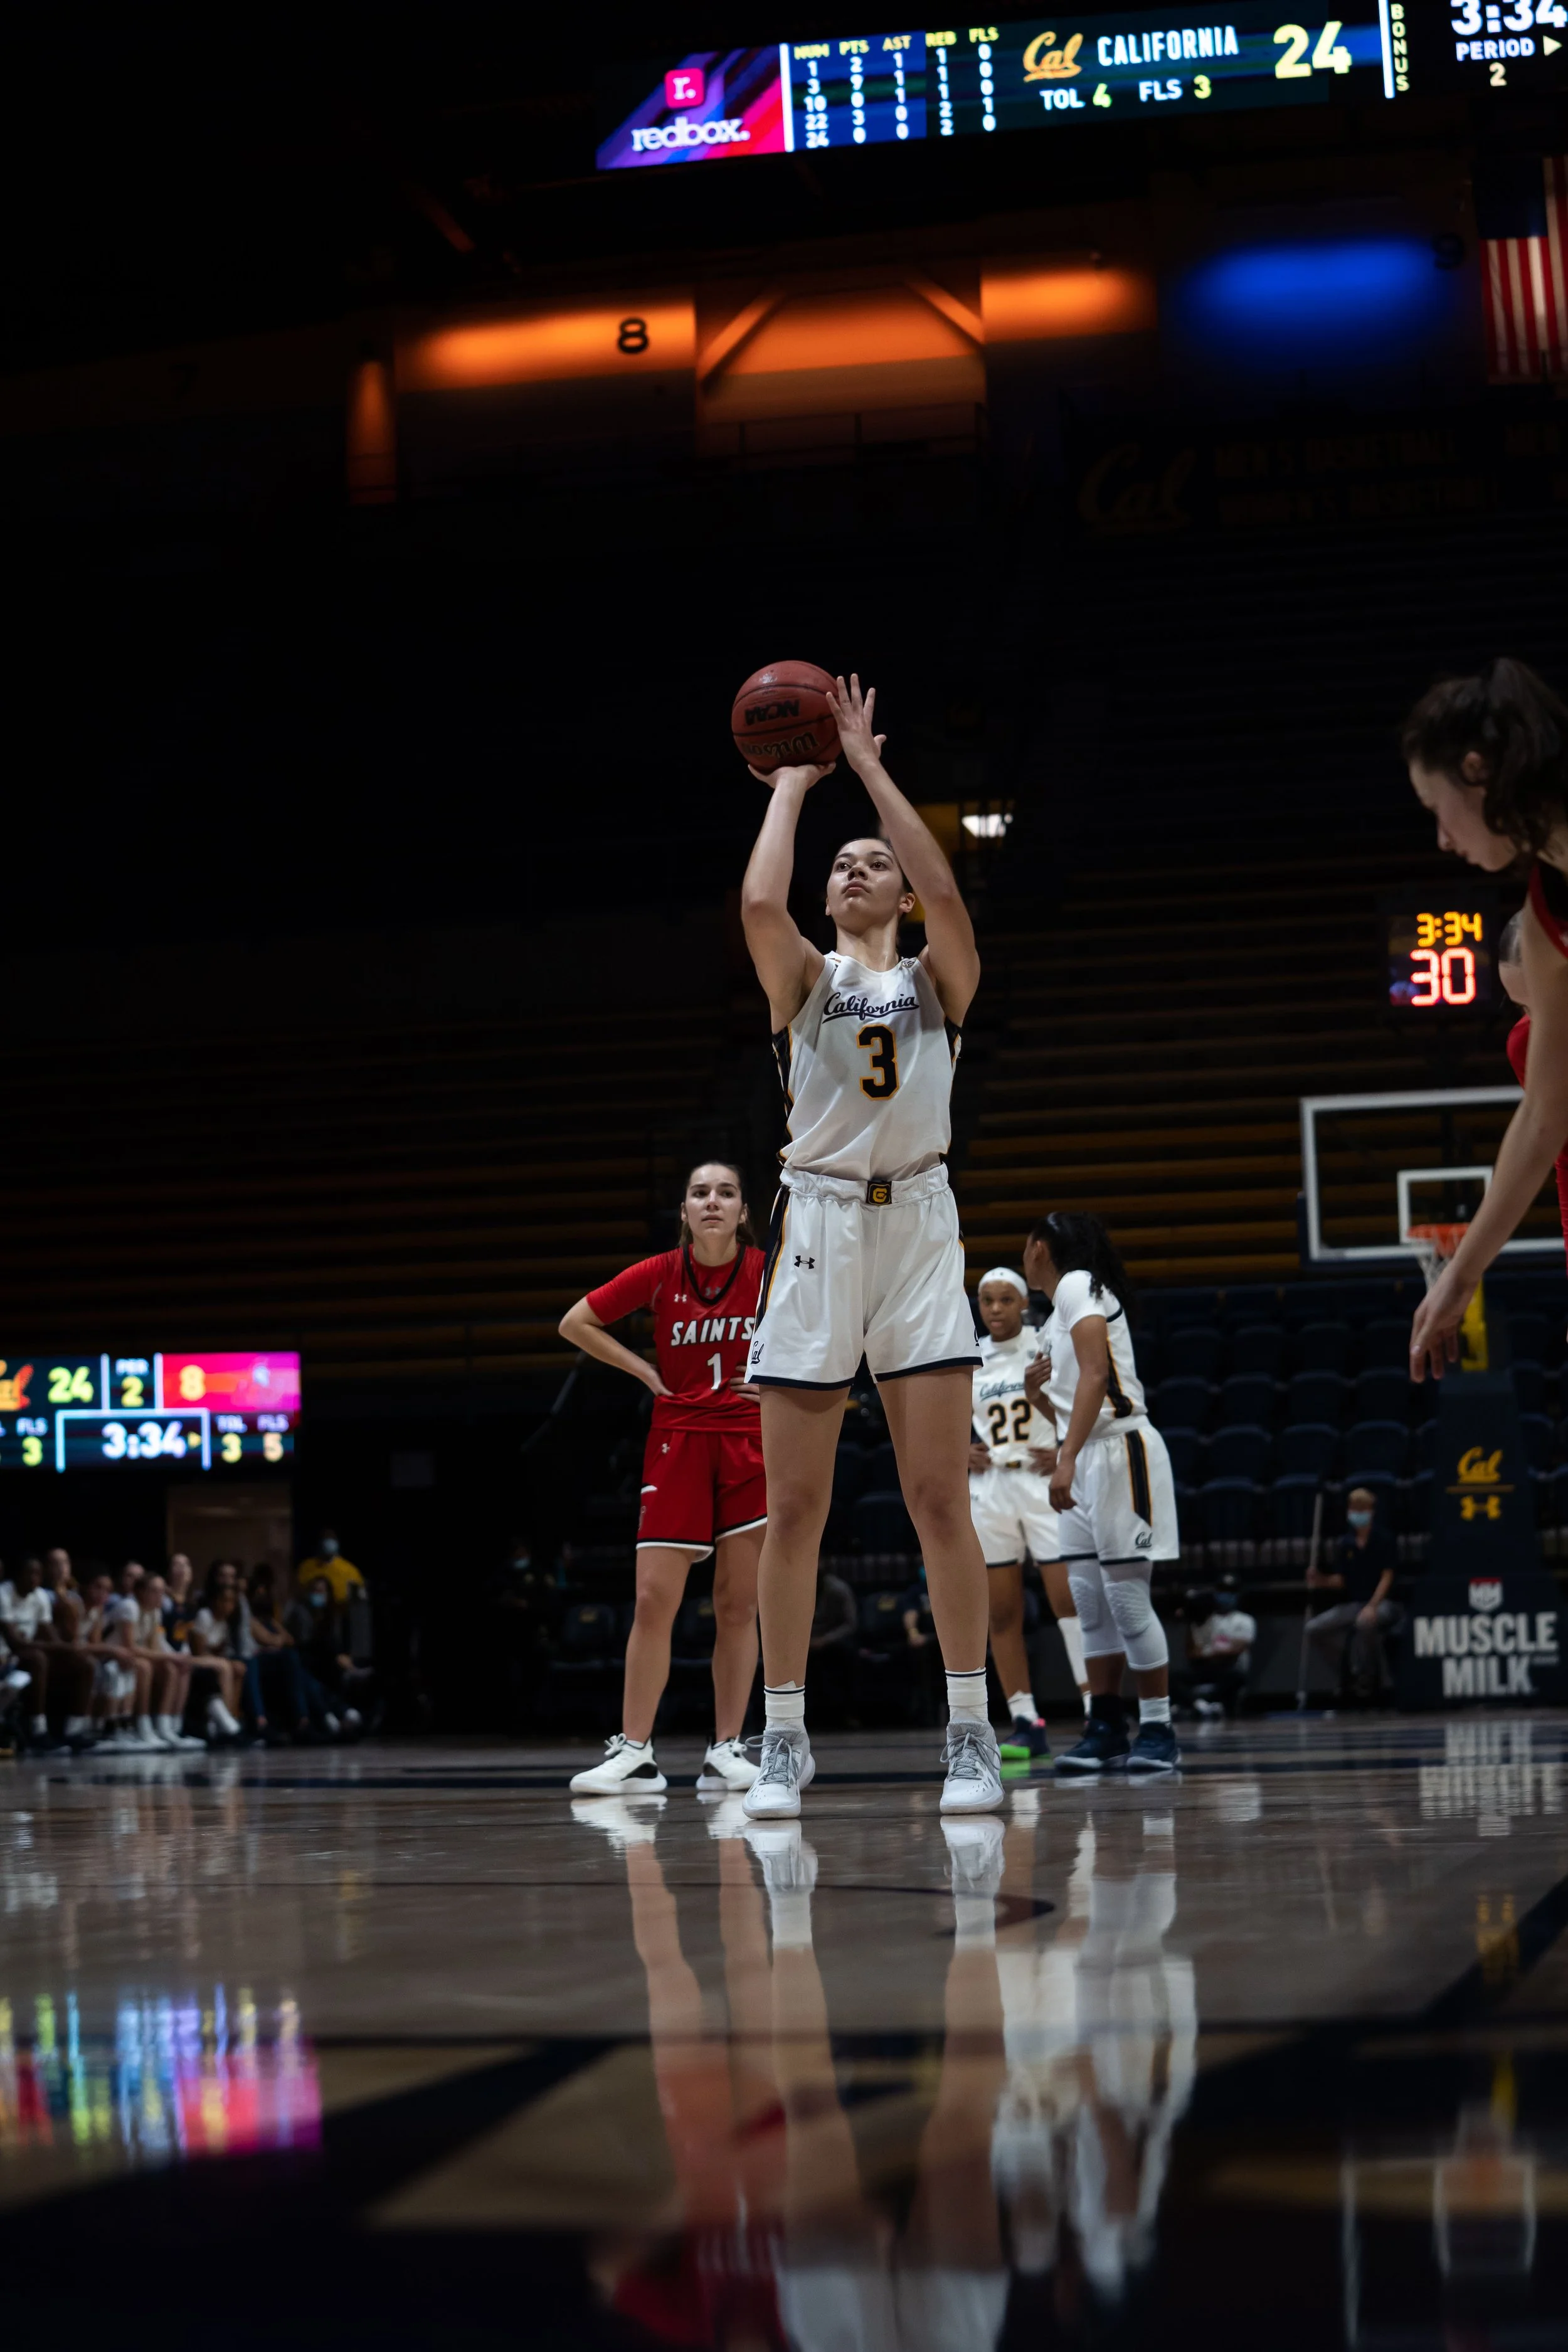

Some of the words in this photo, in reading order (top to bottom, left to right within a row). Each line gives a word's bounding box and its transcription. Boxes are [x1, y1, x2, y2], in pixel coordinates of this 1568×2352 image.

[1450, 0, 1567, 35] 3:34
[794, 43, 829, 60] NUM
[839, 40, 869, 55] PTS
[882, 35, 911, 51] AST
[925, 31, 956, 47] REB
[969, 27, 999, 43] FLS
[807, 60, 817, 77] 1
[850, 56, 863, 73] 2
[893, 52, 903, 68] 1
[936, 48, 946, 64] 1
[978, 43, 991, 60] 0
[1023, 31, 1083, 82] Cal
[1097, 25, 1239, 66] CALIFORNIA
[1273, 21, 1353, 80] 24
[1391, 4, 1409, 91] BONUS
[1456, 37, 1535, 61] PERIOD
[807, 78, 820, 95] 3
[894, 70, 904, 86] 1
[937, 65, 948, 82] 1
[980, 61, 992, 78] 0
[1489, 62, 1507, 87] 2
[803, 95, 827, 112] 10
[851, 92, 864, 108] 0
[895, 87, 905, 103] 1
[938, 83, 949, 100] 1
[980, 79, 993, 95] 0
[1039, 88, 1086, 110] TOL
[1093, 83, 1112, 108] 4
[1139, 79, 1183, 102] FLS
[1194, 75, 1211, 99] 3
[805, 113, 829, 130] 22
[852, 109, 865, 125] 3
[895, 105, 908, 121] 0
[939, 100, 953, 117] 2
[982, 97, 993, 113] 1
[853, 127, 866, 144] 0
[896, 122, 909, 139] 0
[940, 119, 954, 135] 2
[982, 114, 996, 131] 0
[617, 317, 649, 354] 8
[744, 699, 800, 726] NCAA
[1416, 911, 1483, 947] 3:34
[1410, 947, 1476, 1006] 30
[822, 992, 919, 1021] California
[856, 1024, 899, 1101] 3
[670, 1316, 755, 1347] SAINTS
[48, 1366, 94, 1403] 24
[179, 1364, 206, 1401] 8
[707, 1352, 721, 1390] 1
[120, 1375, 144, 1407] 2
[102, 1421, 187, 1459] 3:34
[987, 1398, 1032, 1447] 22
[22, 1436, 43, 1466] 3
[221, 1433, 241, 1463] 3
[263, 1432, 283, 1463] 5
[1458, 1446, 1503, 1484] Cal
[1135, 1531, 1153, 1549] Cal
[1413, 1611, 1559, 1658] MUSCLE
[1443, 1654, 1532, 1698] MILK
